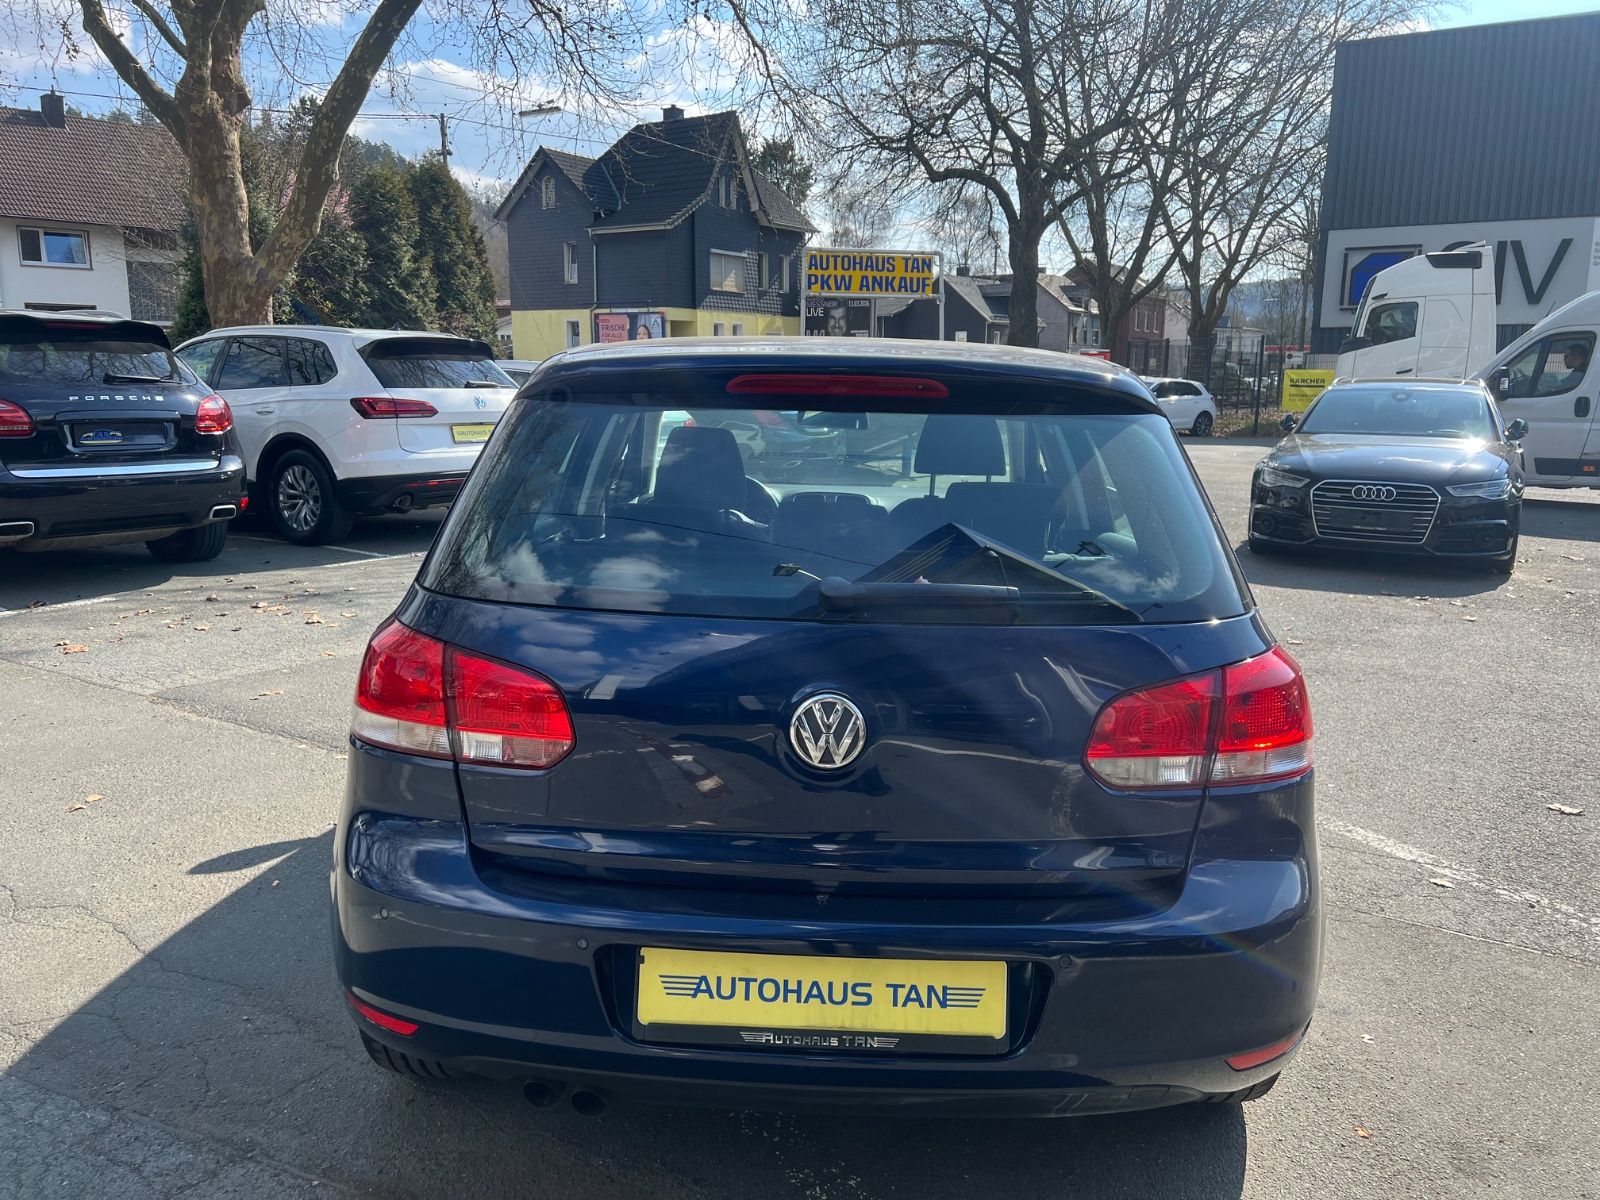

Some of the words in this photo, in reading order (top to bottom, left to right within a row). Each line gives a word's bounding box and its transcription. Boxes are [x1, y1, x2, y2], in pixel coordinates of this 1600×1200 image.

[808, 254, 896, 272] AUTOHAUS
[902, 257, 932, 273] TAN
[1440, 238, 1574, 305] IV
[807, 273, 853, 291] PKW
[859, 275, 931, 293] ANKAUF
[806, 308, 824, 317] LIVE
[691, 975, 873, 1007] AUTOHAUS
[885, 983, 948, 1009] TAN
[842, 1036, 878, 1048] TAN
